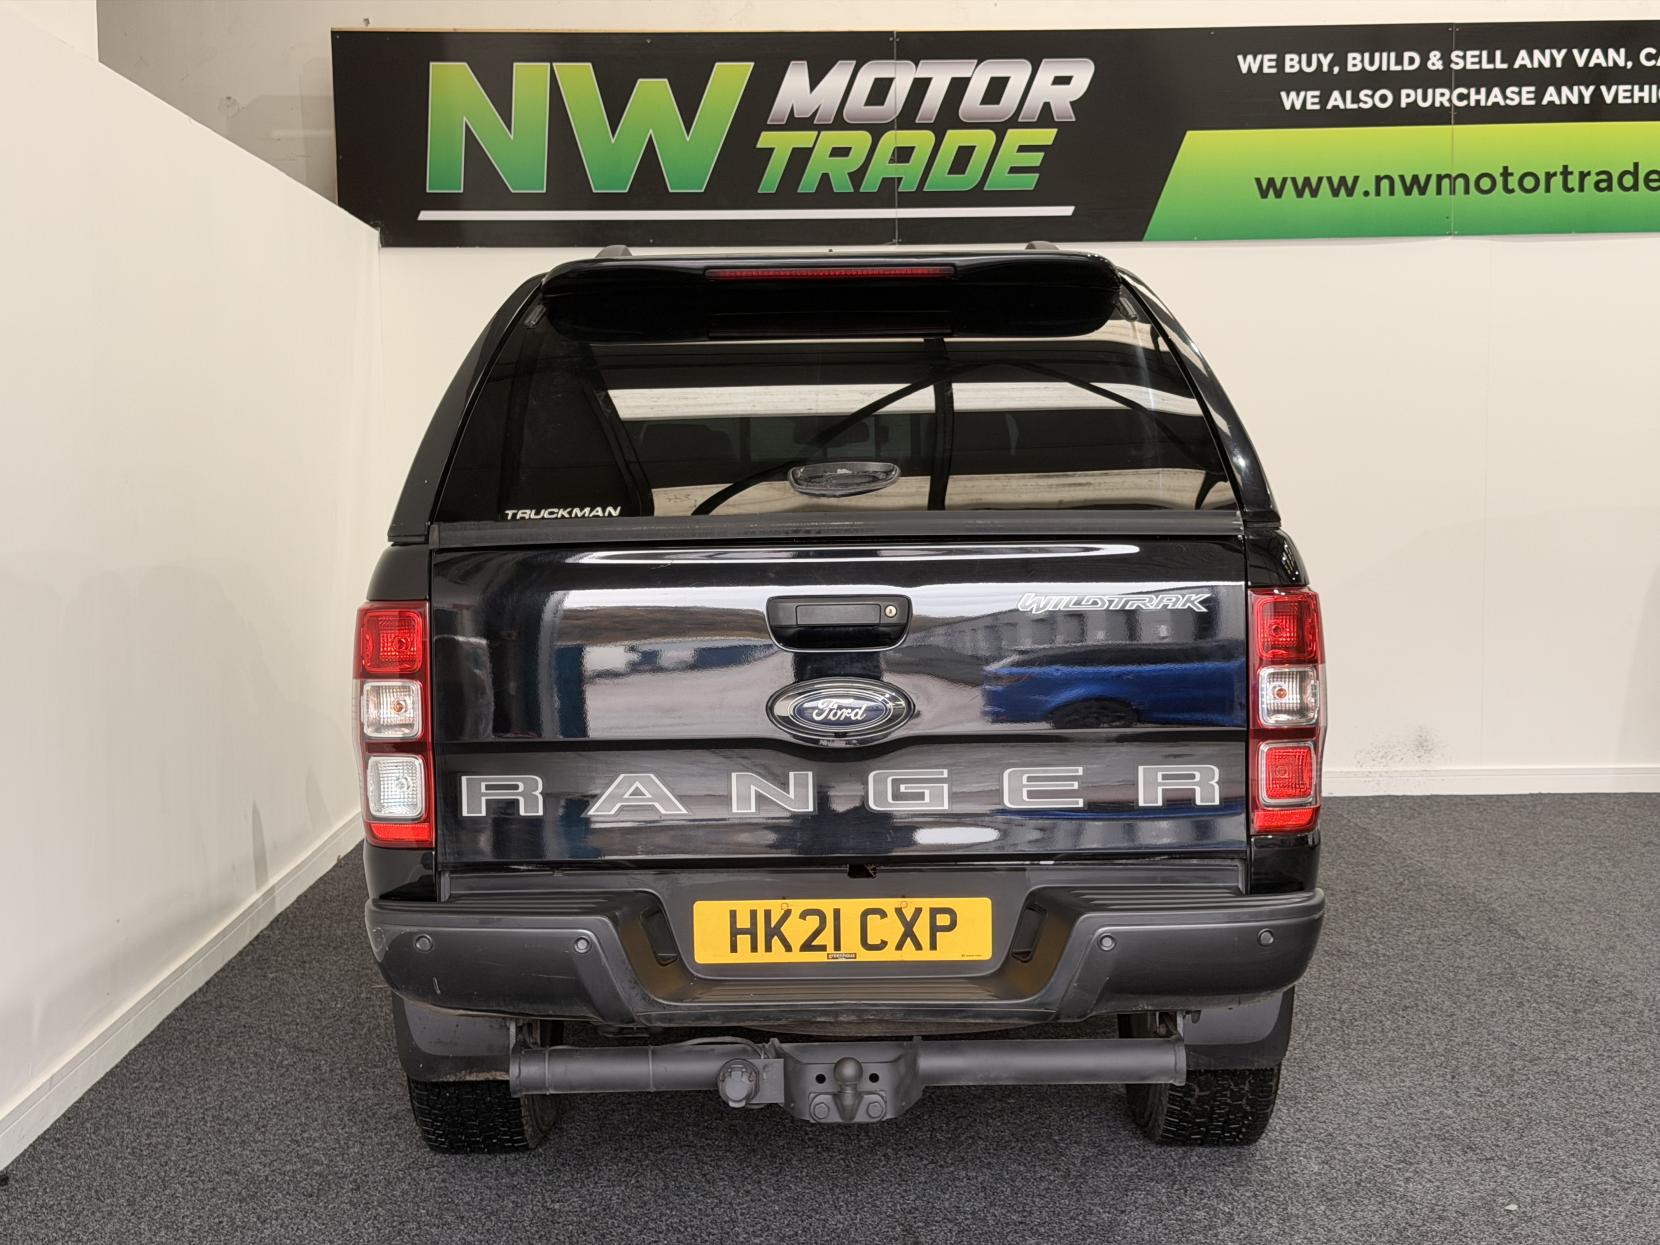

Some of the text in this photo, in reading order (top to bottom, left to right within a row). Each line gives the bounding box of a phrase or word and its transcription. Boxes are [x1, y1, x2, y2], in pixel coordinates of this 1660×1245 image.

[1237, 54, 1277, 74] WE
[1284, 53, 1339, 74] BUY,
[1347, 52, 1420, 72] BUILD
[1426, 51, 1444, 70] &
[1449, 50, 1508, 70] SELL
[1513, 49, 1567, 69] ANY
[1572, 48, 1633, 68] VAN,
[768, 58, 1095, 124] MOTOR
[1280, 90, 1320, 110] WE
[1326, 90, 1393, 109] ALSO
[1400, 87, 1535, 108] PURCHASE
[1541, 86, 1595, 106] ANY
[426, 61, 754, 193] NW
[756, 128, 1058, 193] TRADE
[504, 506, 621, 520] TRUCKMAN
[1018, 592, 1211, 614] WILDTRAK
[812, 699, 867, 722] Ford
[461, 764, 1221, 817] RANGER
[729, 906, 958, 953] HK21 CXP
